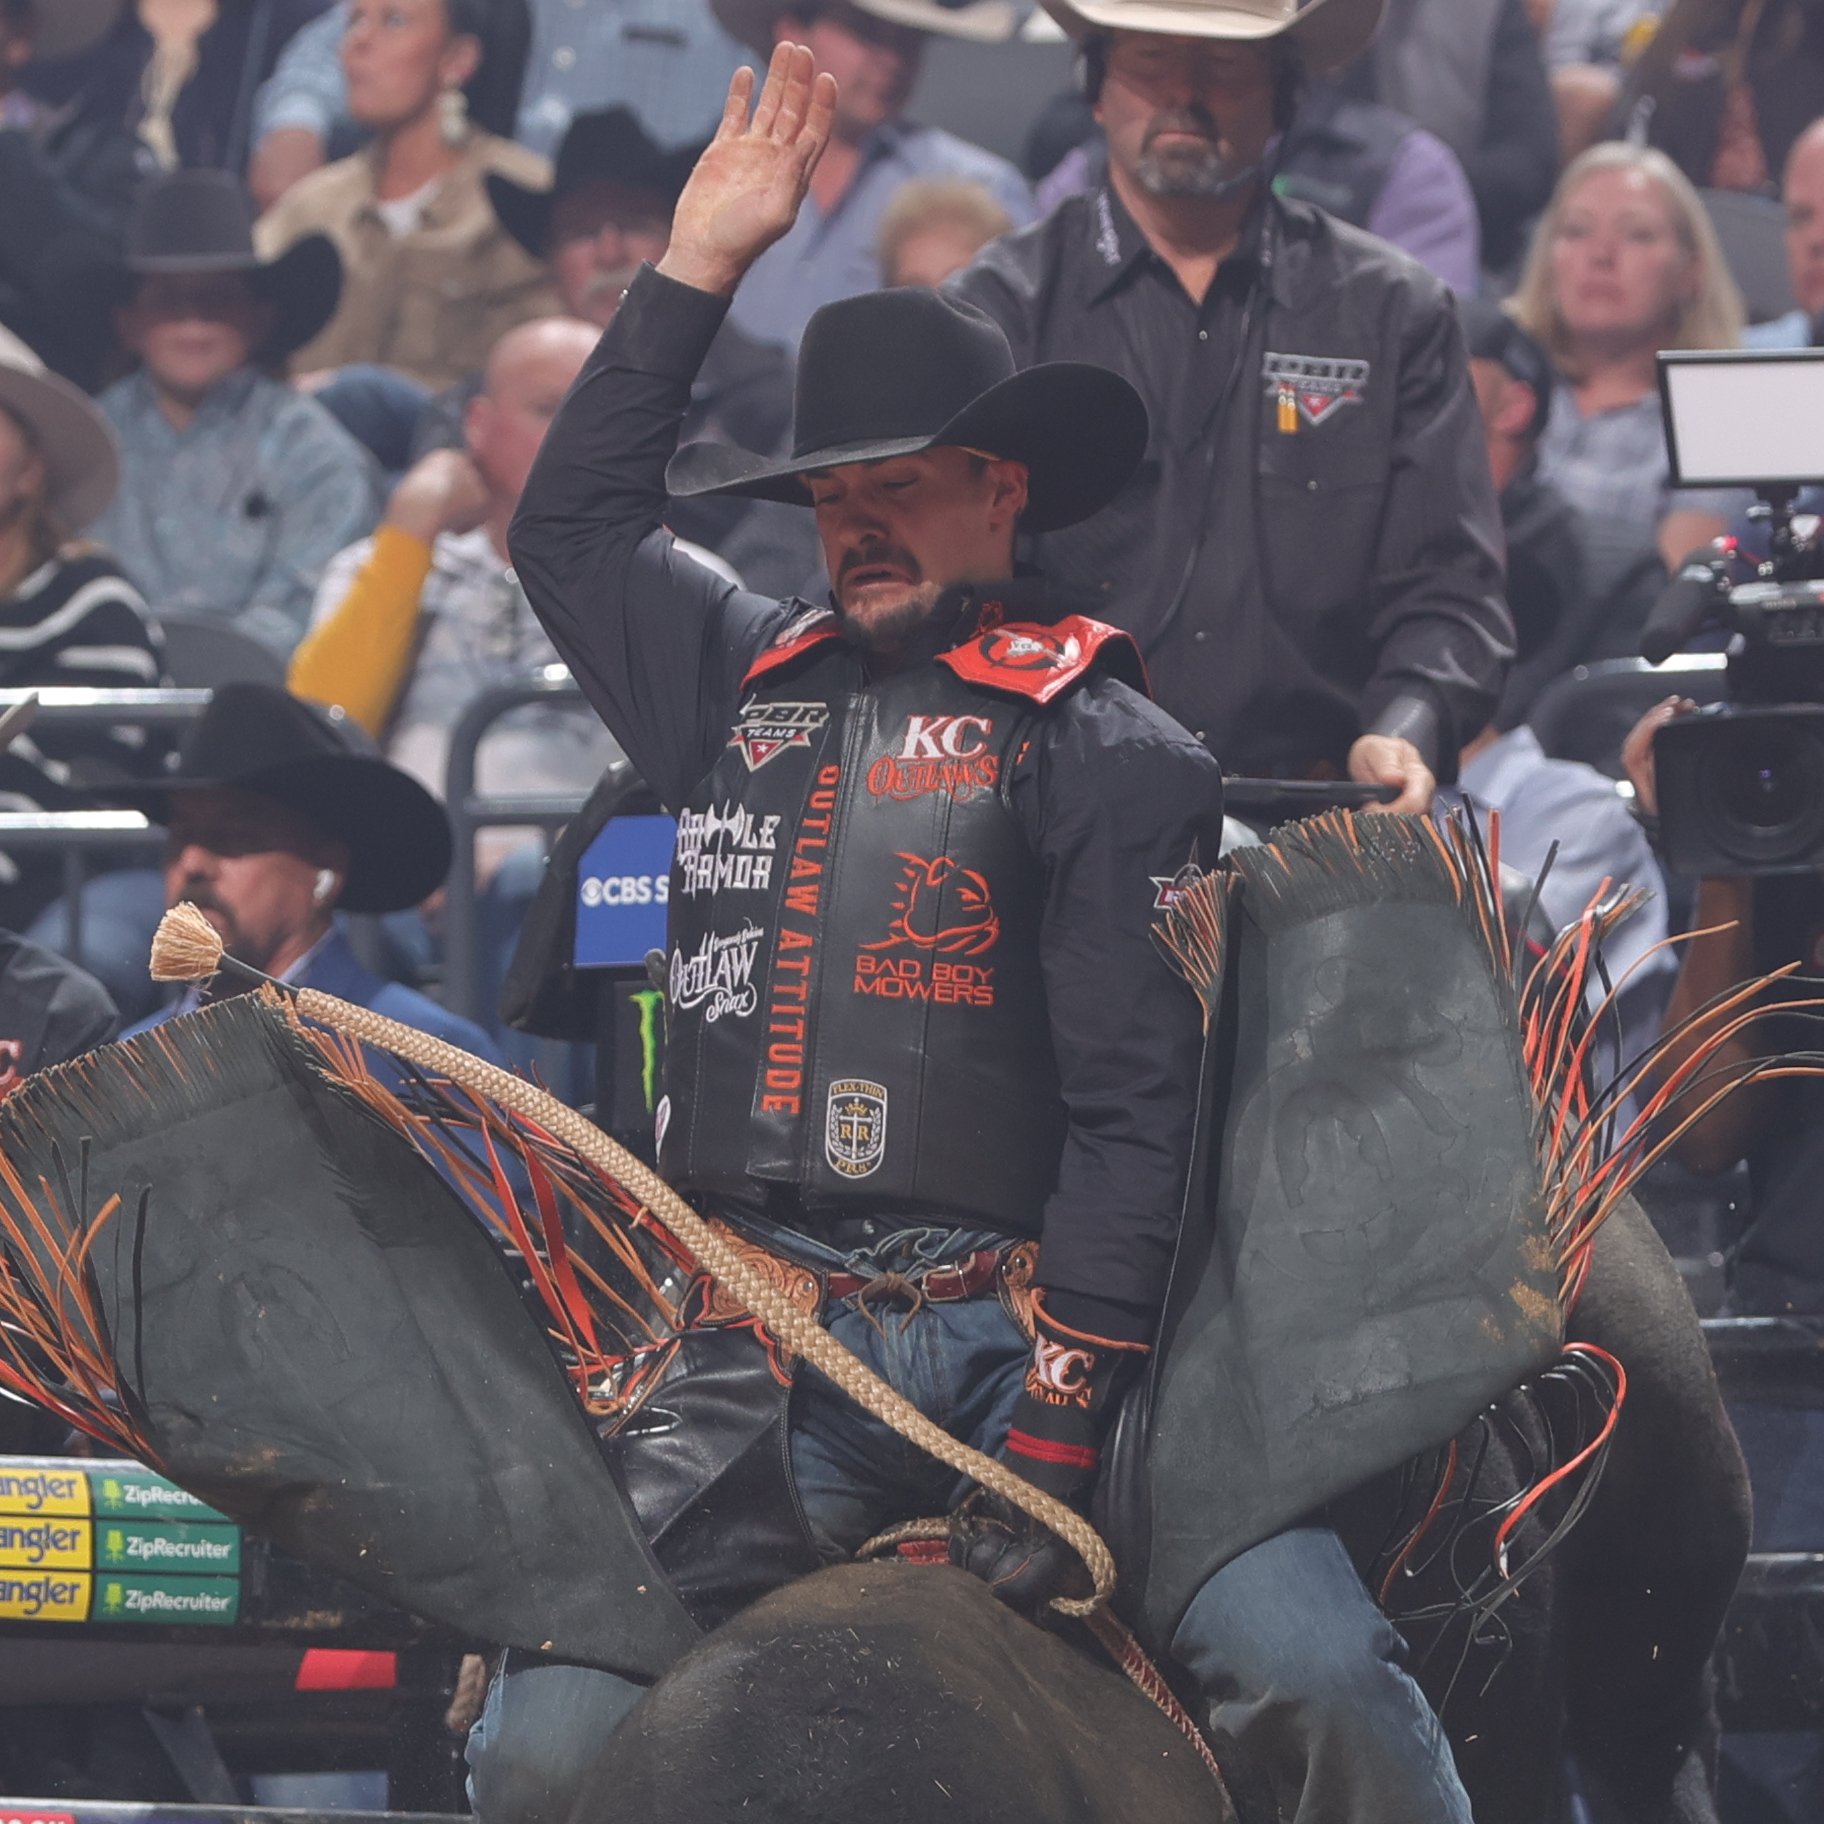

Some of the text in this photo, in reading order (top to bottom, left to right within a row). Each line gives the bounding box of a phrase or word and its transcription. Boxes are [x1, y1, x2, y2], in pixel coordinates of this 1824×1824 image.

[747, 728, 796, 738] TEAMS
[897, 715, 993, 762] KC
[602, 875, 652, 905] CBS
[761, 764, 840, 1114] OUTLAW ATTITUDE
[856, 954, 994, 984] BAD BOY
[854, 974, 994, 1005] MOWERS
[126, 1536, 231, 1561] ZipRecruiter
[125, 1588, 231, 1615] ZipRecruiter
